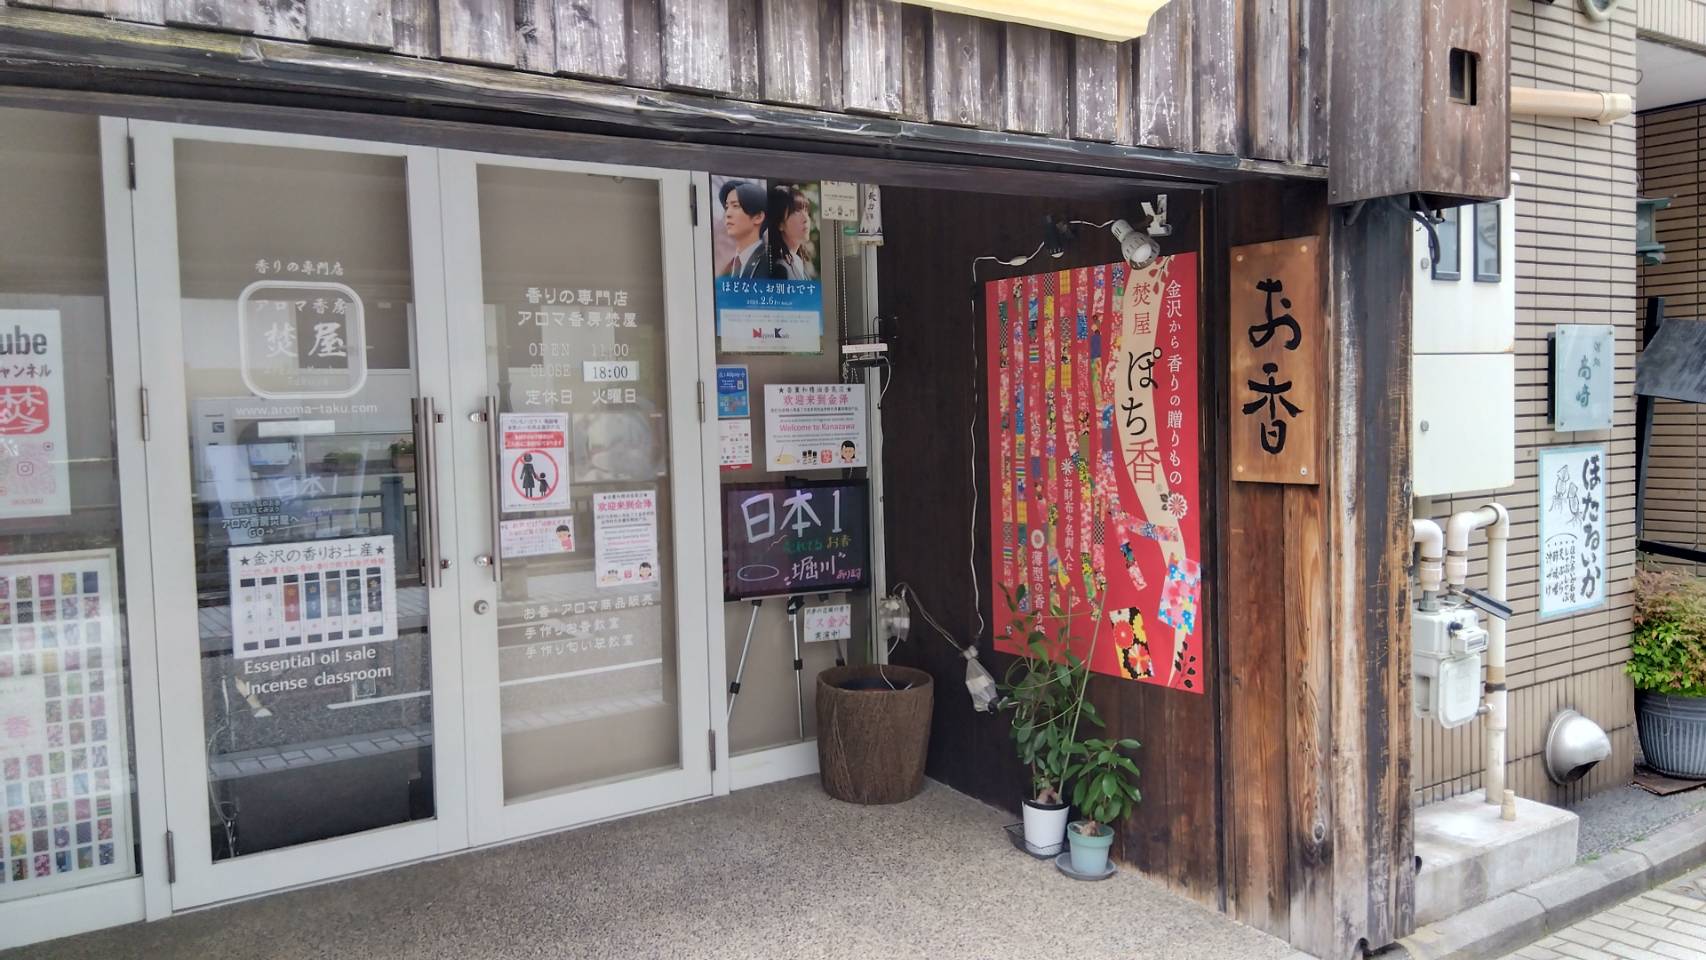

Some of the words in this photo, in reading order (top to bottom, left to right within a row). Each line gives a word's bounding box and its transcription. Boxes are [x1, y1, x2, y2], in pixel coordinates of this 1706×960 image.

[255, 258, 344, 276] 香りの専門店
[526, 287, 629, 306] 香りの専門店
[722, 281, 816, 295] ほどなく、お別れです
[529, 342, 570, 356] OPEN
[592, 366, 628, 379] 18:00
[1242, 278, 1304, 455] お香
[1165, 279, 1183, 485] 金沢から香りの贈りもの
[525, 390, 573, 405] 定休日
[592, 388, 637, 404] 火曜日
[235, 402, 378, 416] www.aroma-taku.com
[779, 423, 811, 432] Welcome
[1581, 454, 1602, 599] ほたるいか
[253, 542, 373, 566] 金沢の香りお土産
[244, 651, 315, 675] Essential
[320, 648, 340, 665] oil
[345, 645, 377, 663] sale
[246, 676, 307, 696] Incense
[314, 665, 392, 692] classroom
